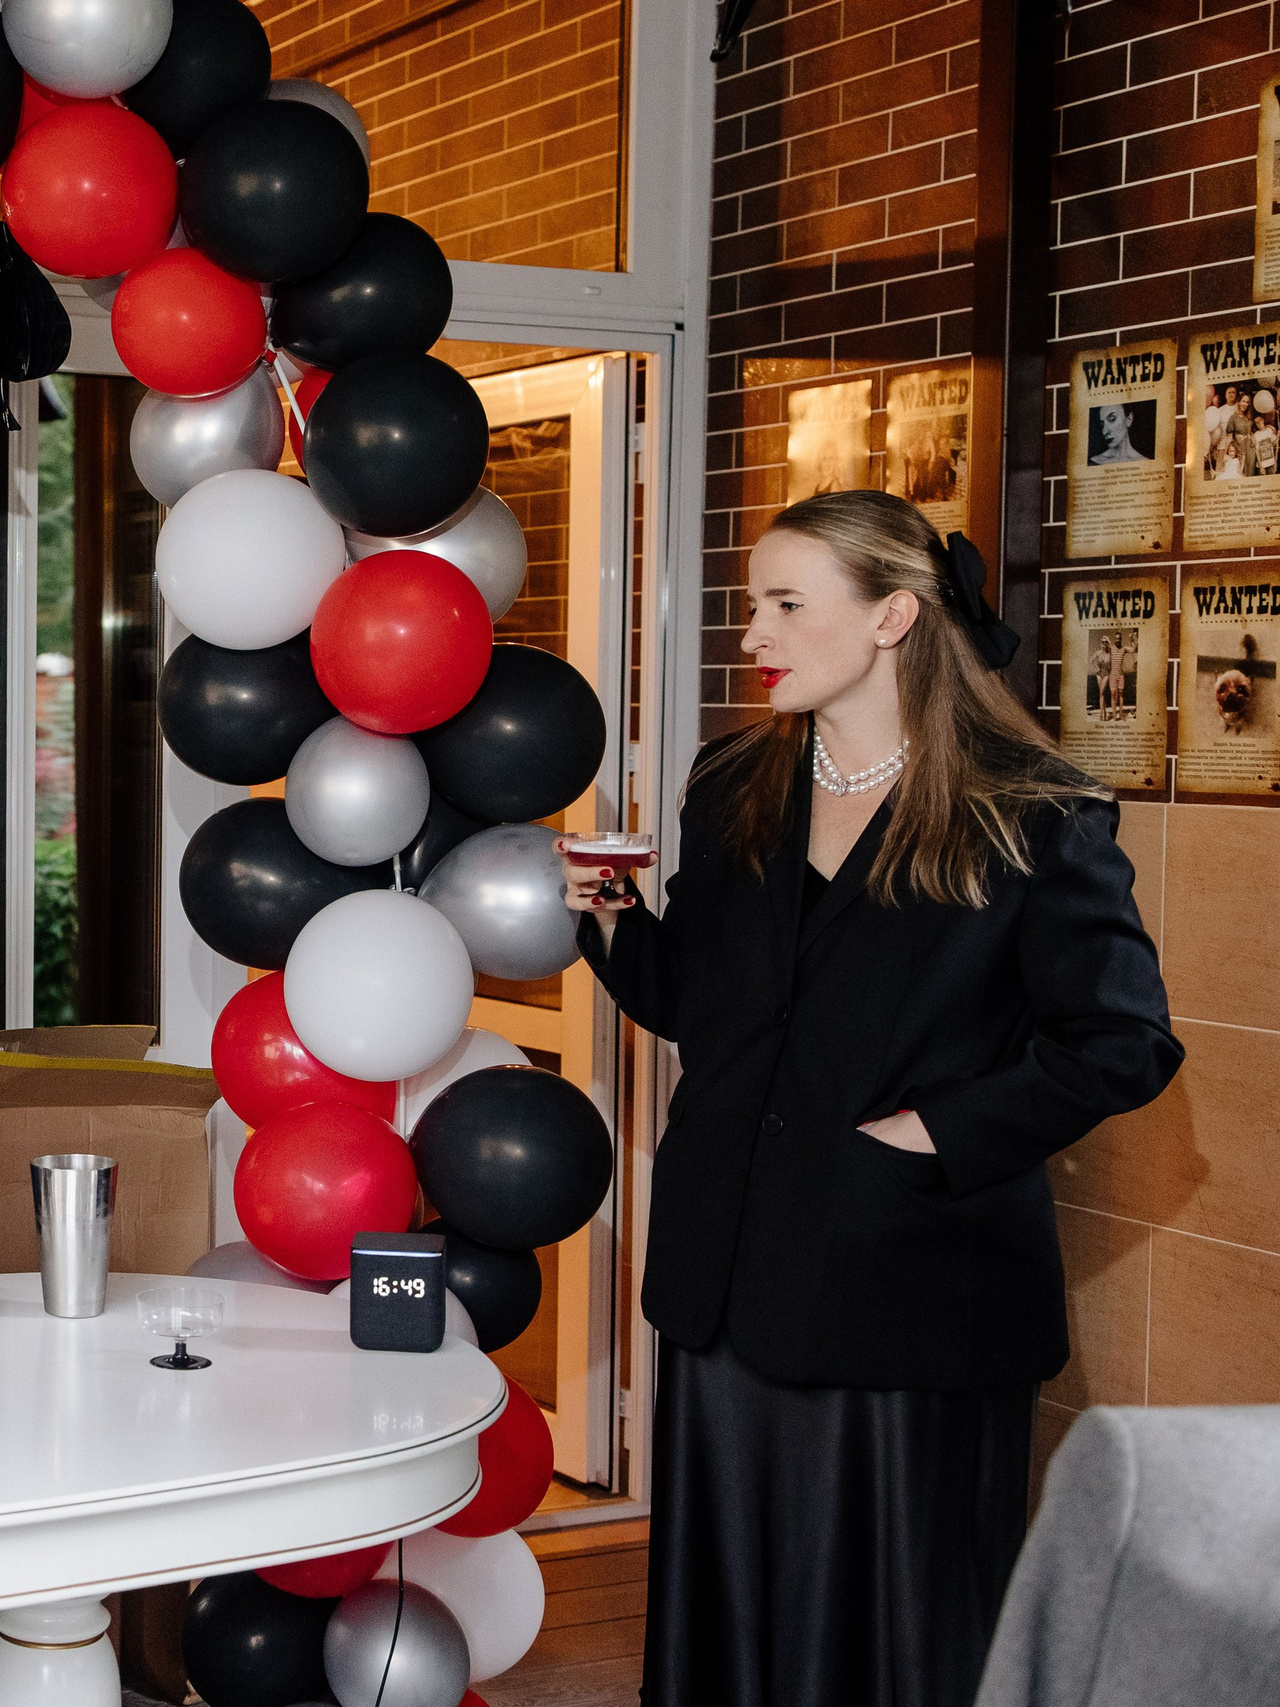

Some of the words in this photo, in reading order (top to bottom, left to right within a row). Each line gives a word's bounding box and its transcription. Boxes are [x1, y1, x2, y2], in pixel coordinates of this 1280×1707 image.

[1201, 334, 1280, 373] WANTE
[1082, 353, 1164, 390] WANTED
[901, 379, 969, 411] WANTED
[1074, 590, 1155, 621] WANTED
[373, 1276, 426, 1298] 16:49
